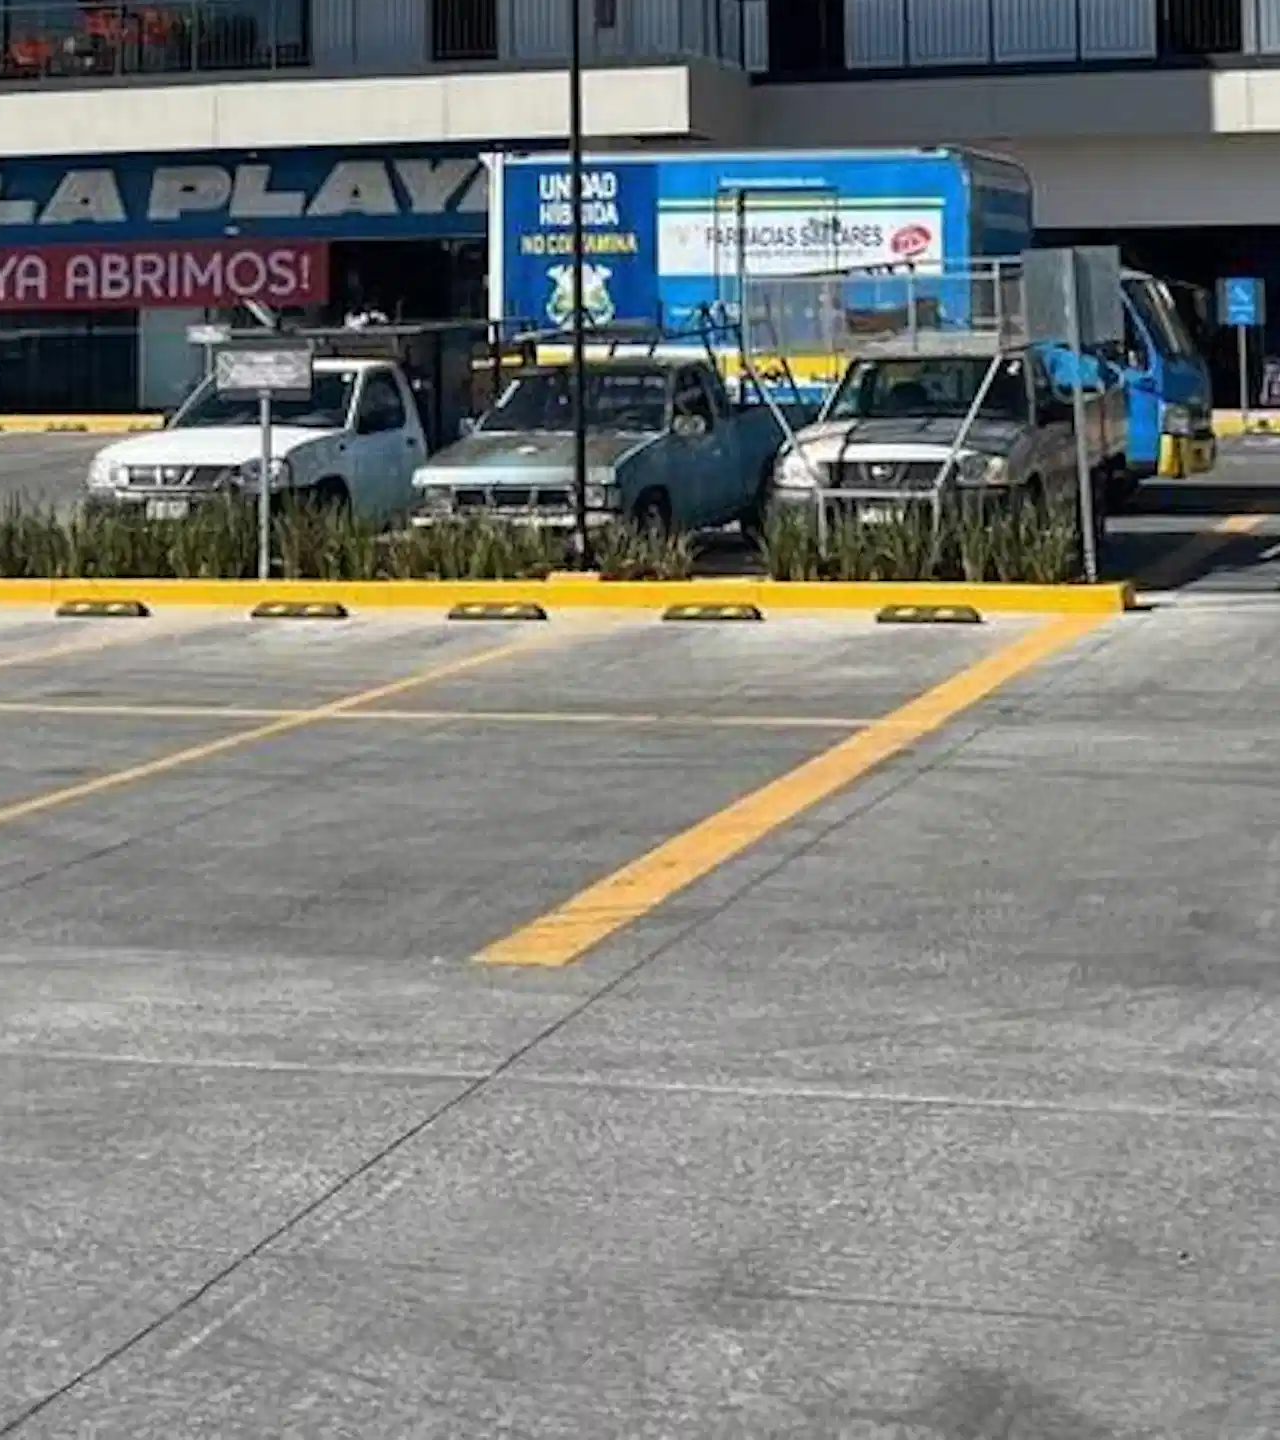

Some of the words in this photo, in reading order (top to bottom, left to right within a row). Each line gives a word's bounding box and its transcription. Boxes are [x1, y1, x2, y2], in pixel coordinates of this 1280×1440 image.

[539, 171, 617, 200] UNDAD
[539, 201, 619, 227] HIBIDA
[65, 250, 310, 300] ABRIMOS!
